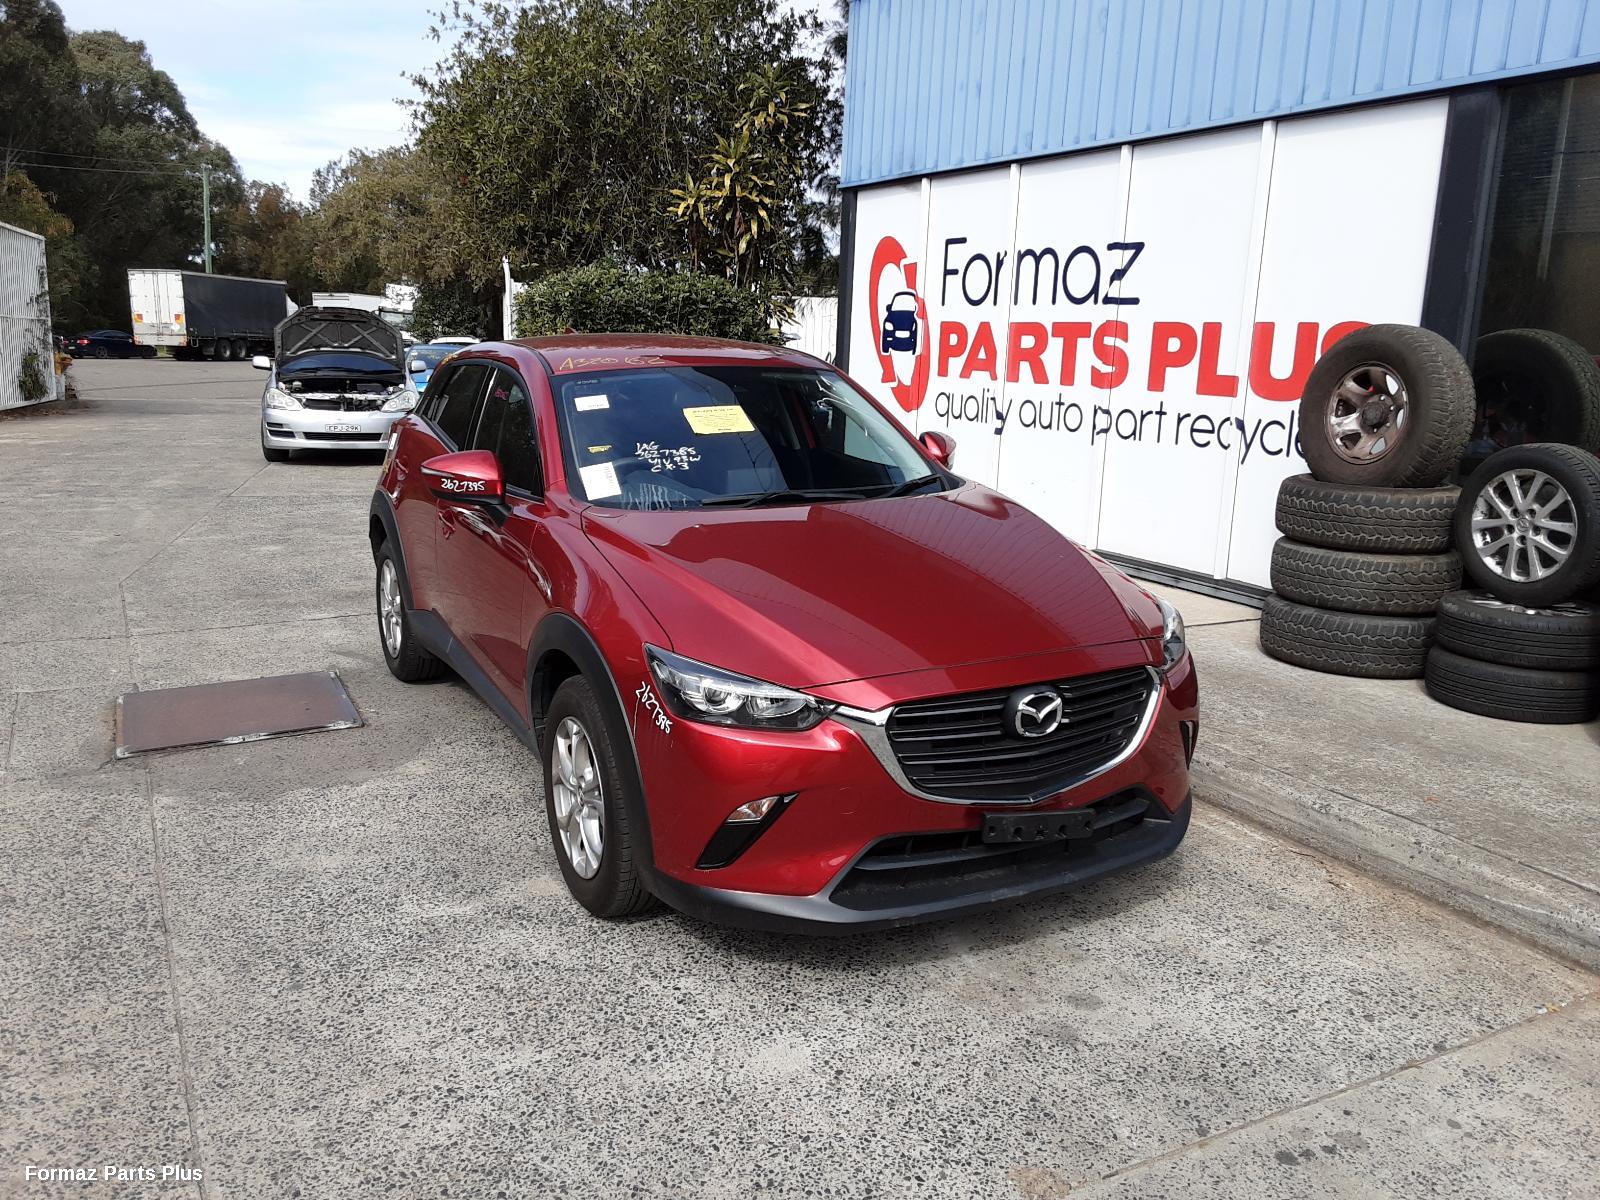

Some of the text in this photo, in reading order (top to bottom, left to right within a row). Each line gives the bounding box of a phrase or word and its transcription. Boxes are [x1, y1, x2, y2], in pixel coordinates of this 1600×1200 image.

[941, 236, 1146, 306] Formaz
[936, 319, 1374, 402] PARTS PLU
[935, 387, 1013, 436] quality
[1018, 395, 1083, 433] auto
[1091, 401, 1168, 447] part
